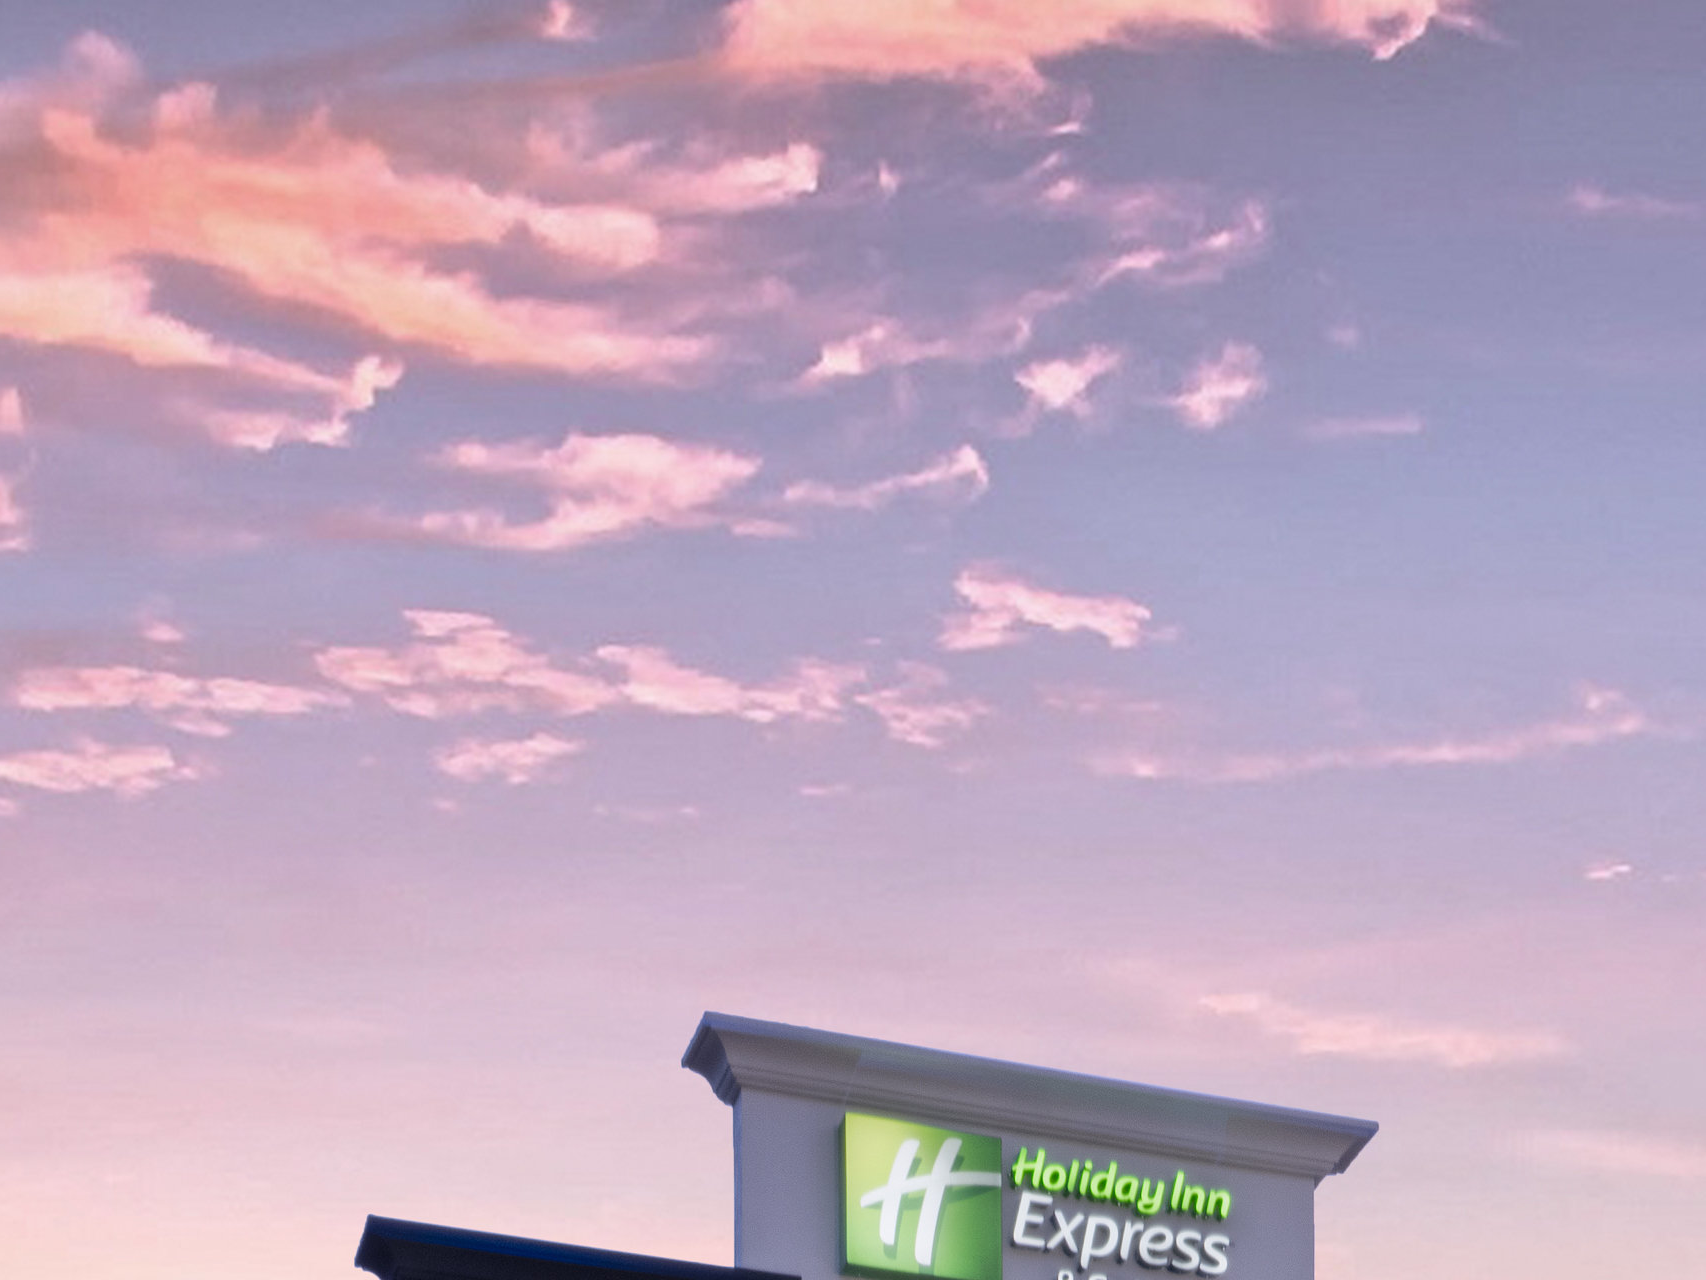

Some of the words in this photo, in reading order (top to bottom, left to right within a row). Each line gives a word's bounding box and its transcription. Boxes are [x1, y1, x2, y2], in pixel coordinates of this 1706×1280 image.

[1012, 1148, 1164, 1216] Holiday
[1171, 1171, 1230, 1218] Inn
[1012, 1190, 1230, 1275] Express
